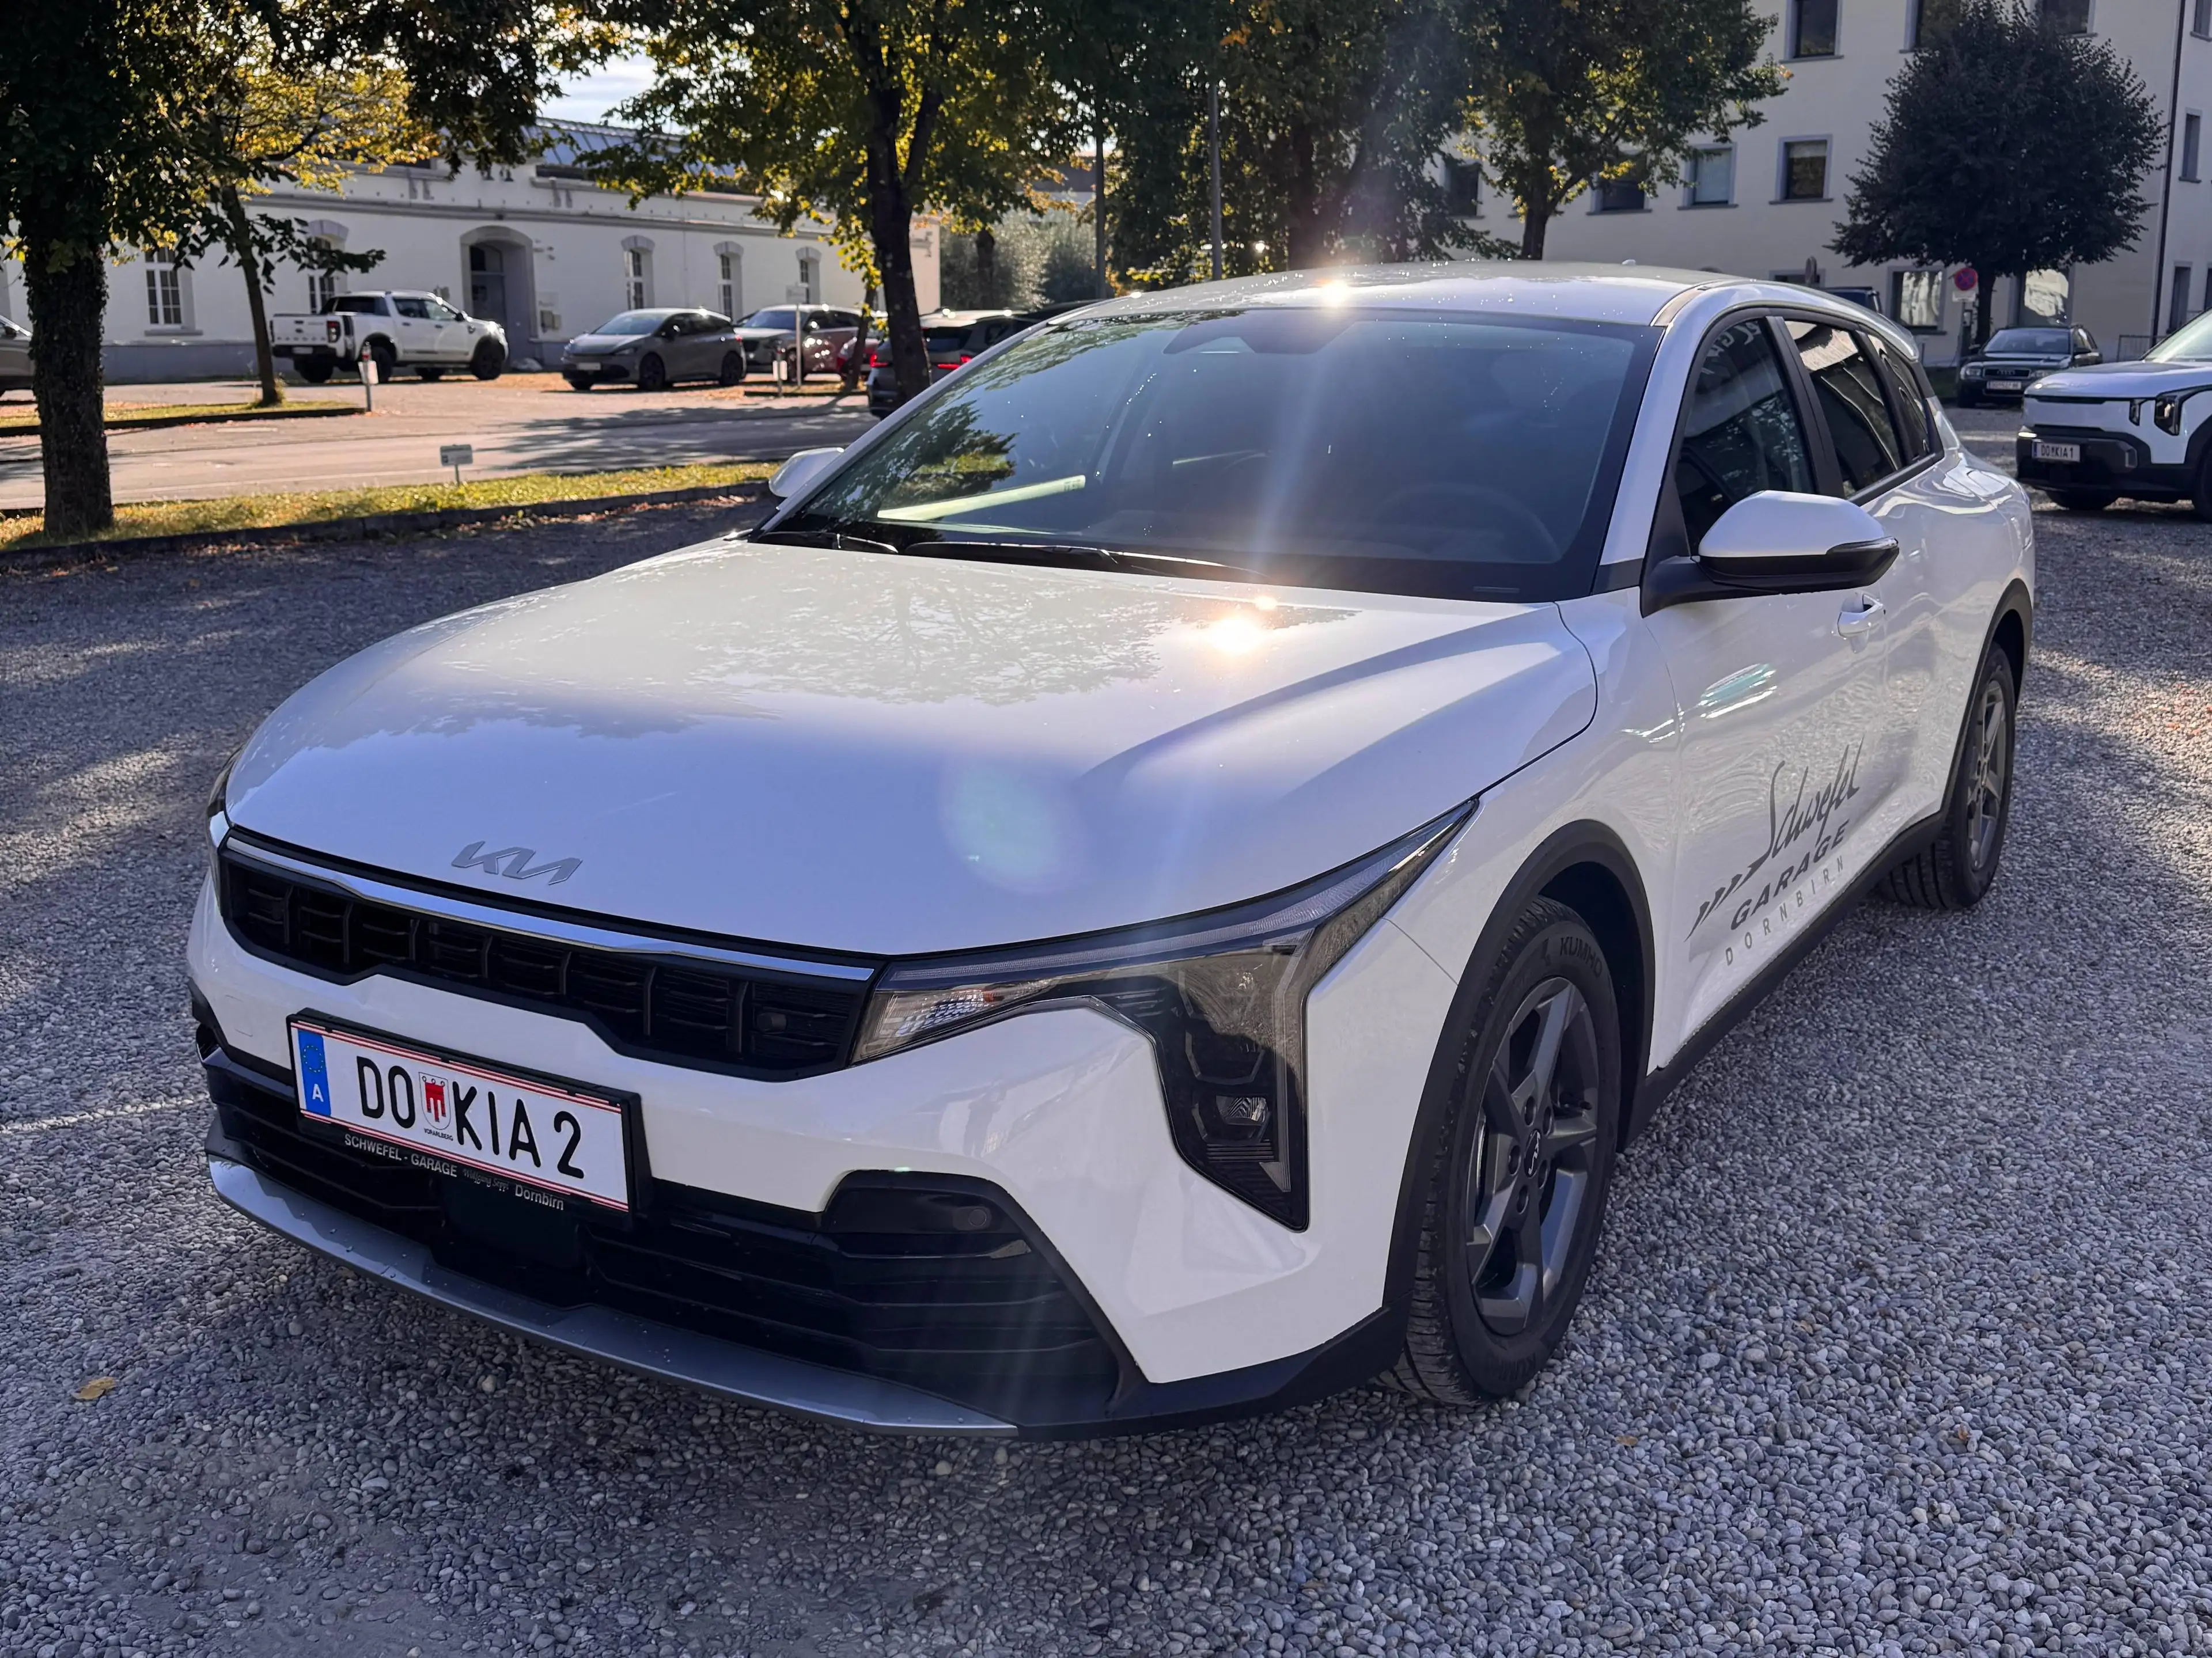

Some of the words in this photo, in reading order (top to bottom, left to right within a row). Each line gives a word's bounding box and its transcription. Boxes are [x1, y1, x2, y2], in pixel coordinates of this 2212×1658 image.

[1733, 734, 1865, 893] Schwefel
[1725, 855, 1844, 966] DORNBIRN
[1730, 818, 1850, 930] GARAGE
[1560, 936, 1603, 978] KUMHO
[312, 1083, 324, 1102] A
[357, 1056, 416, 1129] DO
[452, 1081, 541, 1168] KIA
[554, 1110, 585, 1179] 2
[344, 1133, 402, 1161] SCHWEFEL
[411, 1154, 457, 1178] GARAGE
[514, 1183, 564, 1211] Dornbirn
[423, 1128, 453, 1141] VORARLBERG
